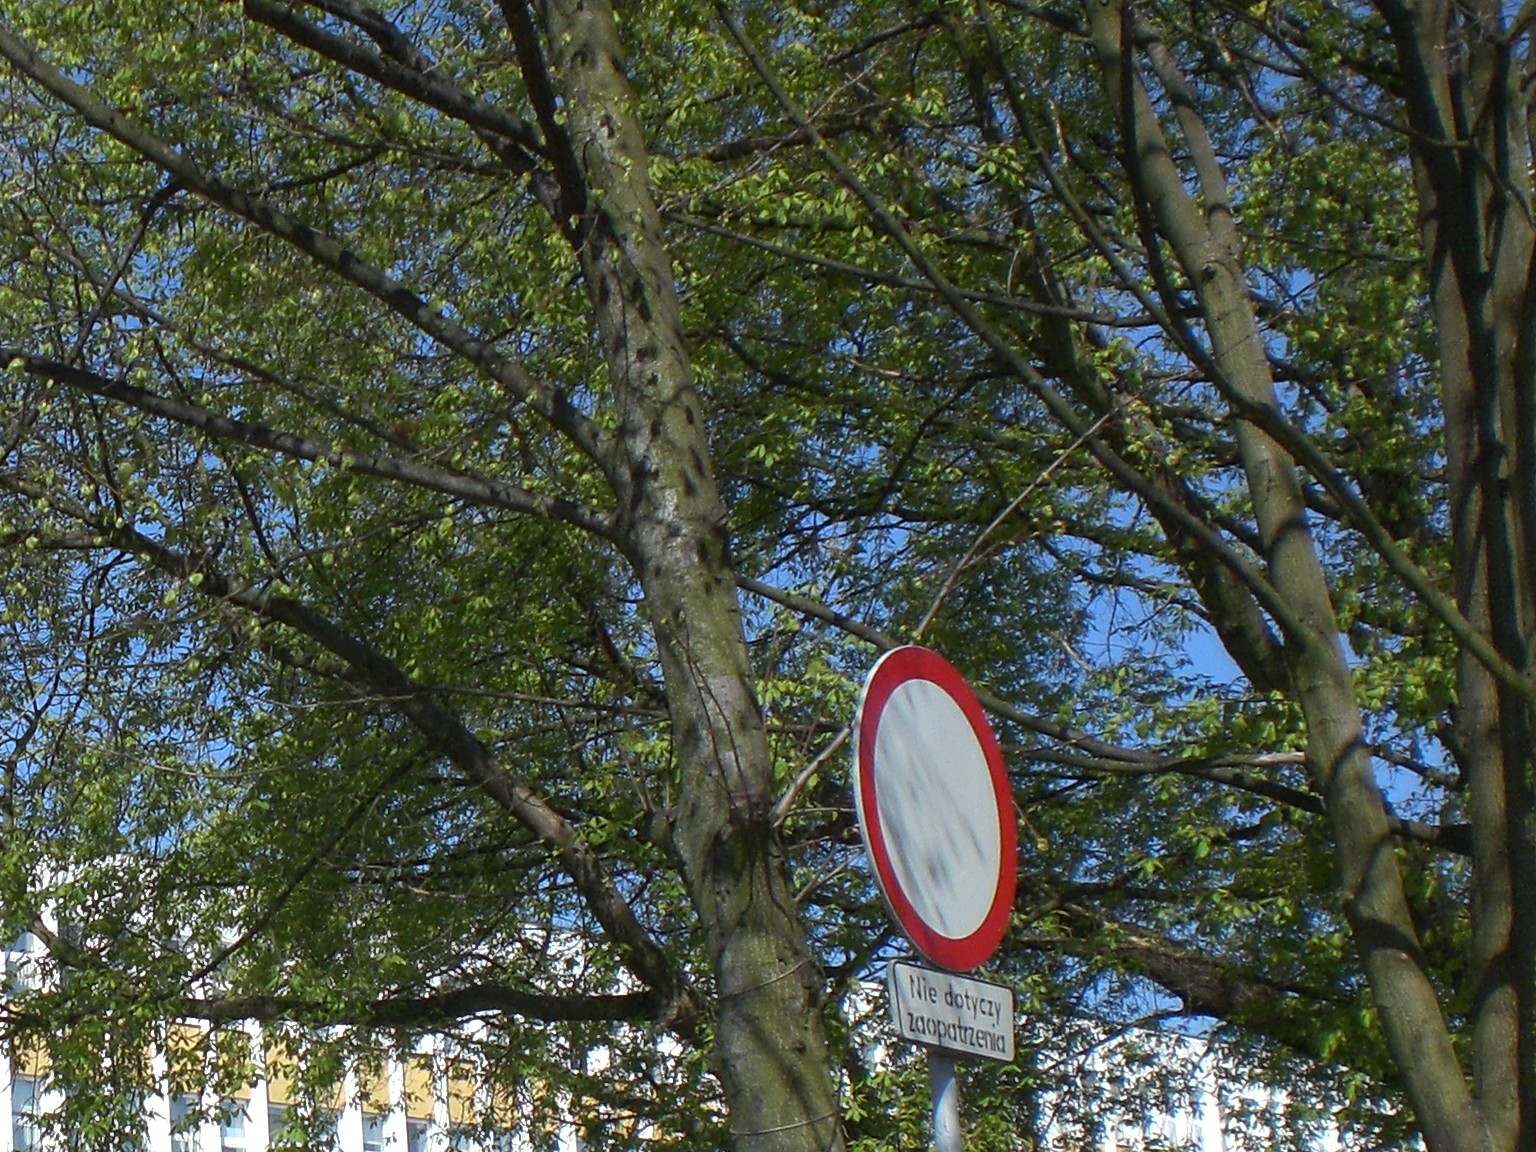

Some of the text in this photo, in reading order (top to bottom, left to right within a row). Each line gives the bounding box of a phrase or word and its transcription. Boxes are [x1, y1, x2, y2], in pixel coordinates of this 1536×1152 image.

[909, 973, 1002, 1026] Nie dotyczy
[906, 1012, 1006, 1055] zaopatrzenia
